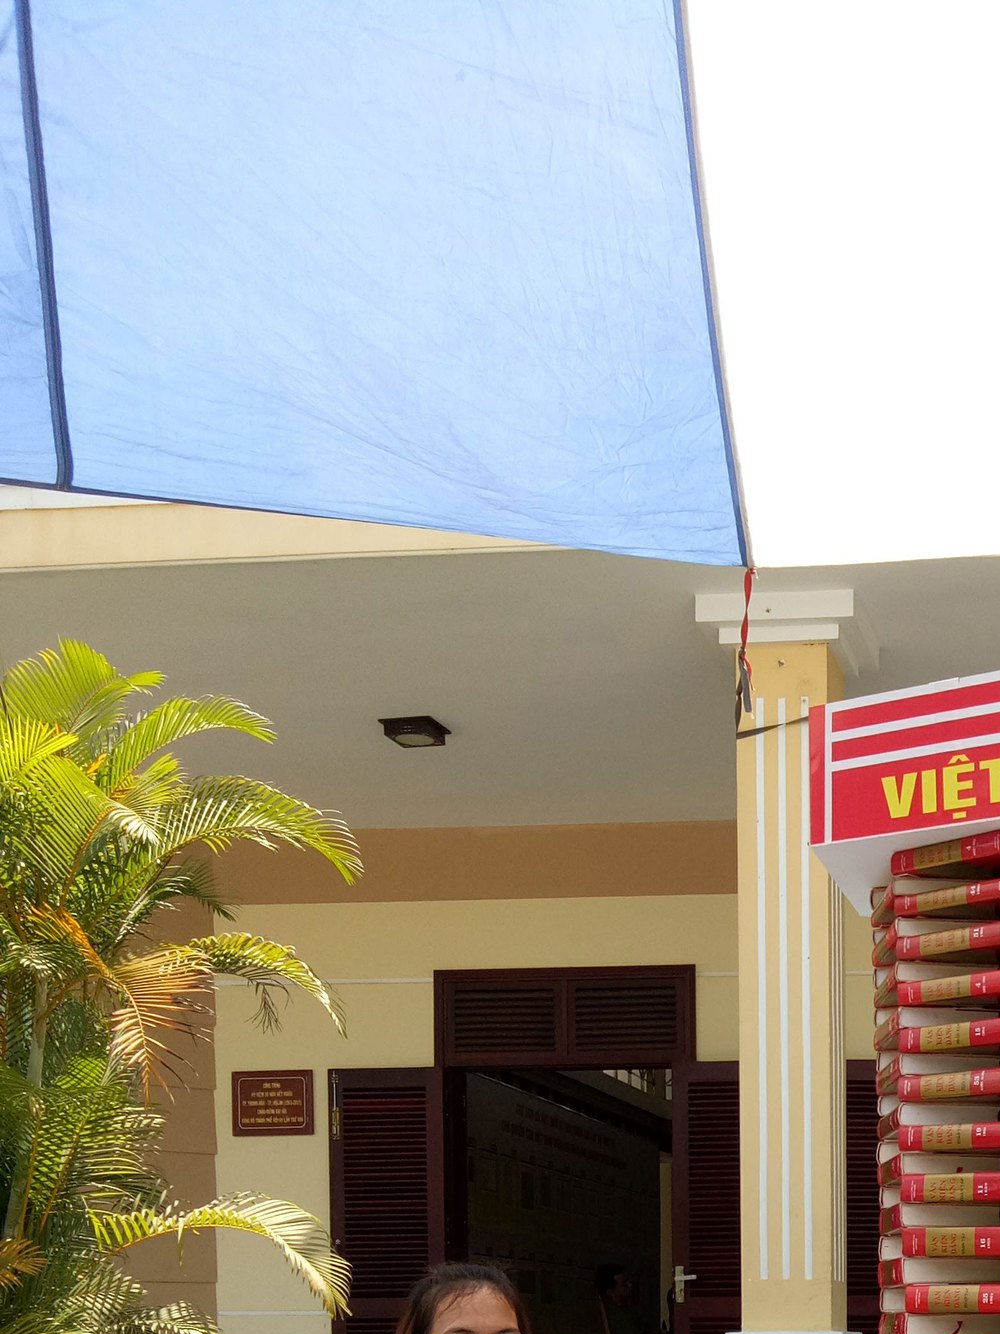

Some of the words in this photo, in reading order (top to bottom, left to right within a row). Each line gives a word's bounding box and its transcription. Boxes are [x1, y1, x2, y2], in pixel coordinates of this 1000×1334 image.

[974, 1027, 980, 1036] 15
[978, 1184, 983, 1194] 11
[982, 1292, 989, 1304] 25
